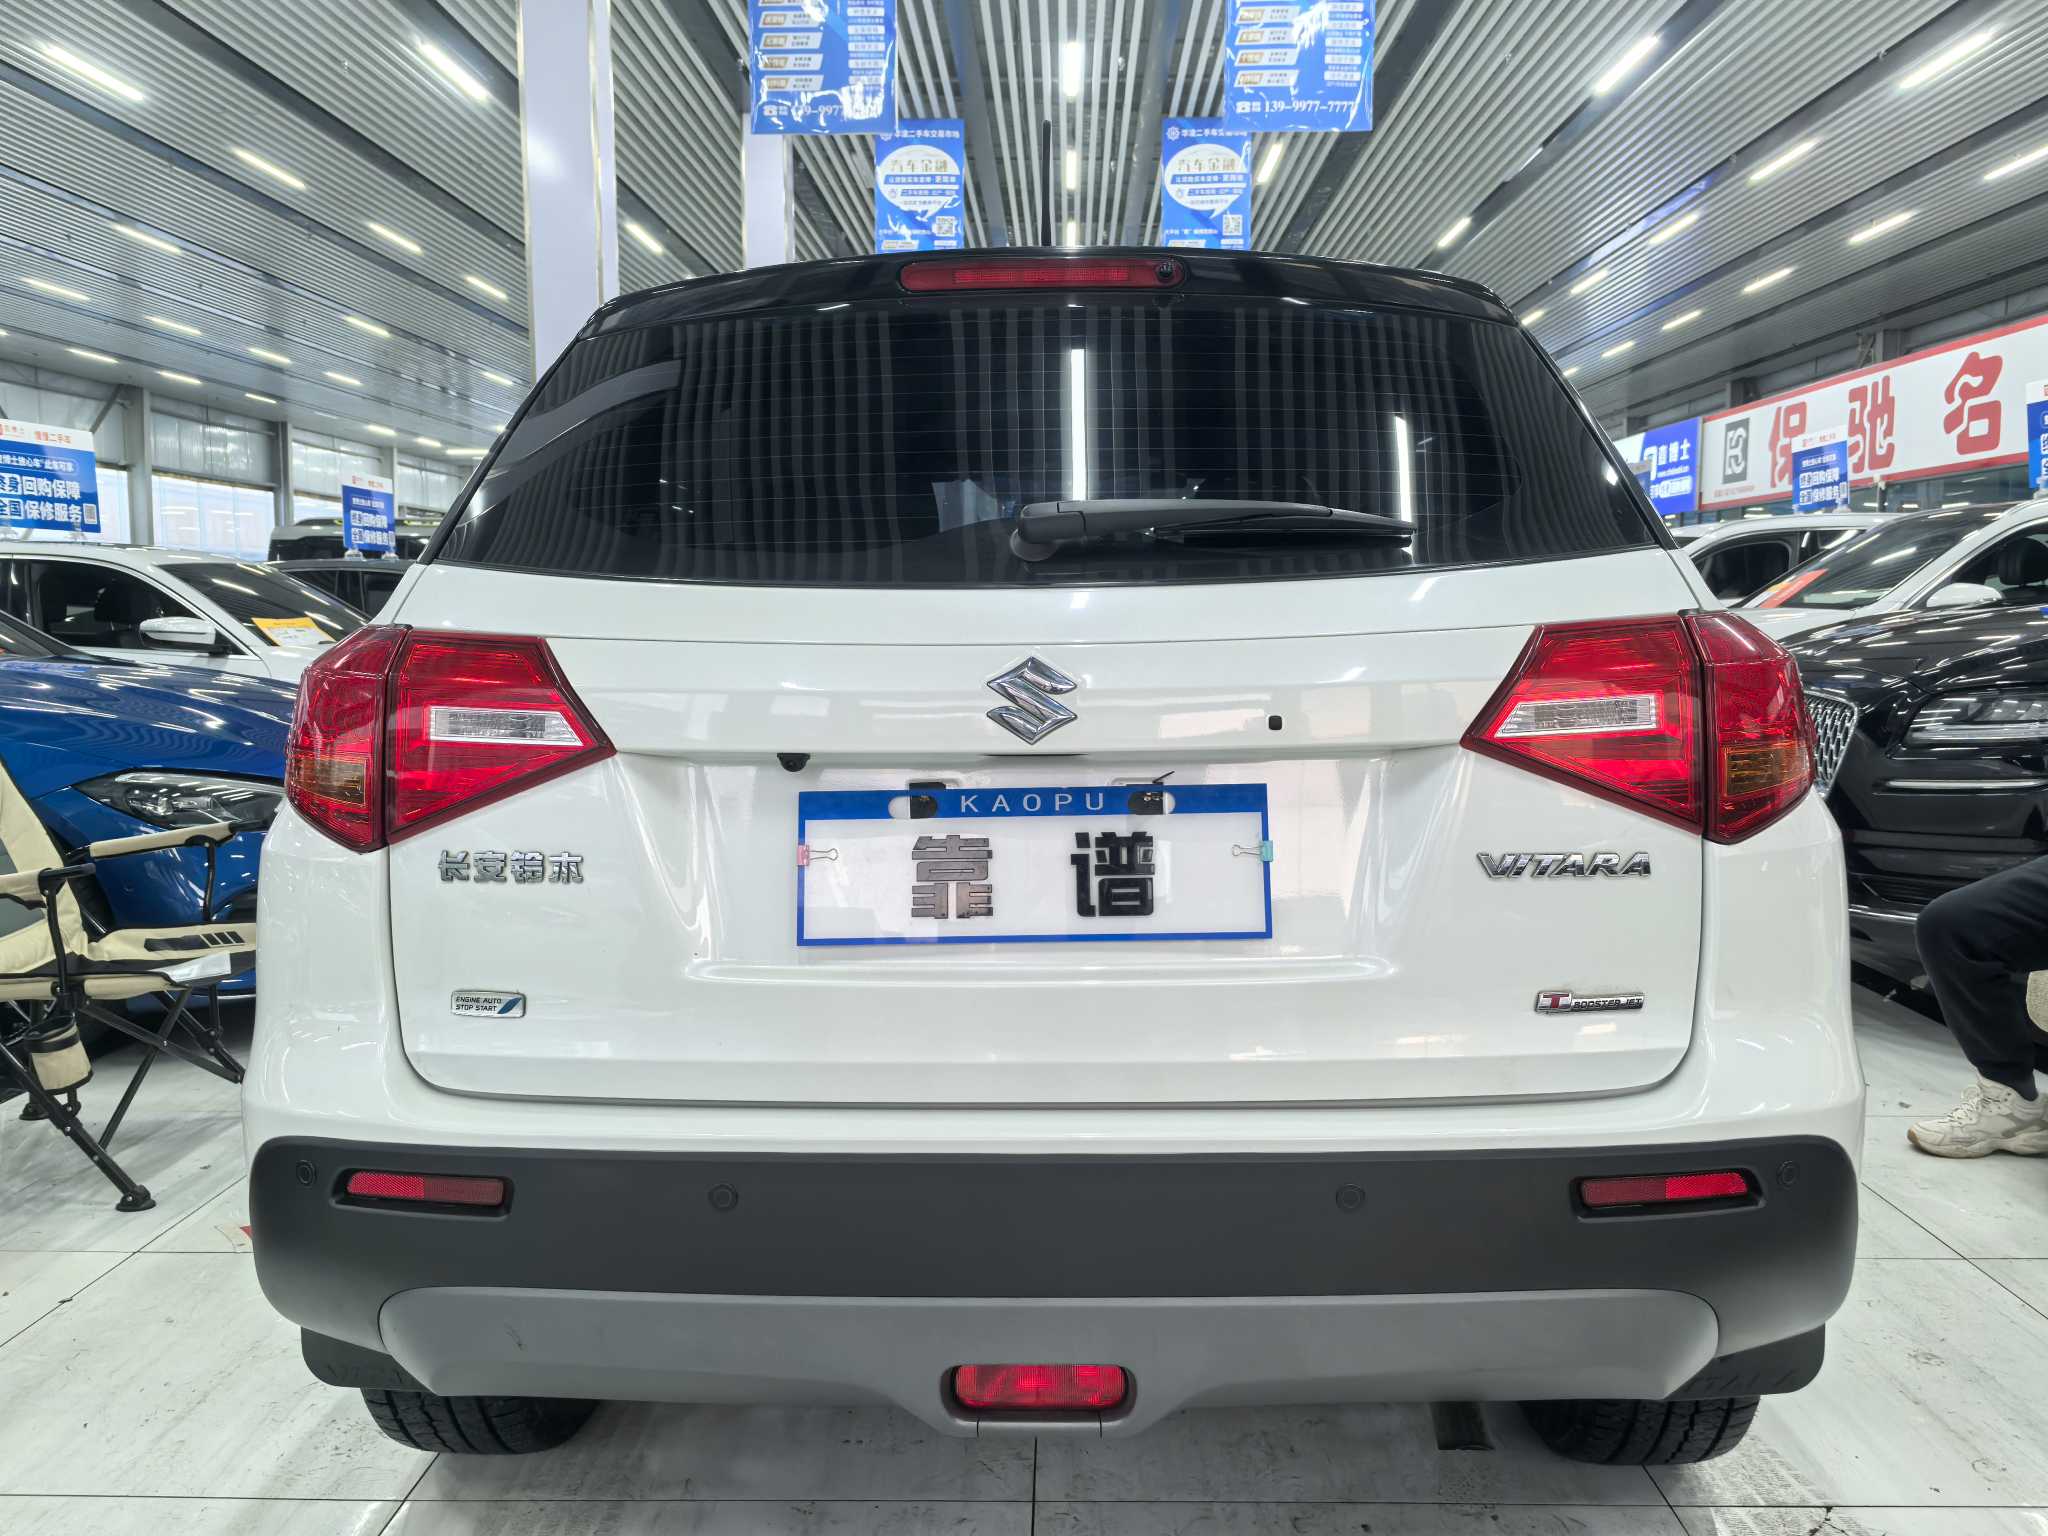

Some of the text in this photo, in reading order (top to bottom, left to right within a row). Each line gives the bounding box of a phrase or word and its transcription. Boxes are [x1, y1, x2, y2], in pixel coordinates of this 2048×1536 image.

[961, 792, 1104, 813] KAOPU
[438, 850, 584, 884] 长安铃木
[1477, 852, 1651, 879] VITARA
